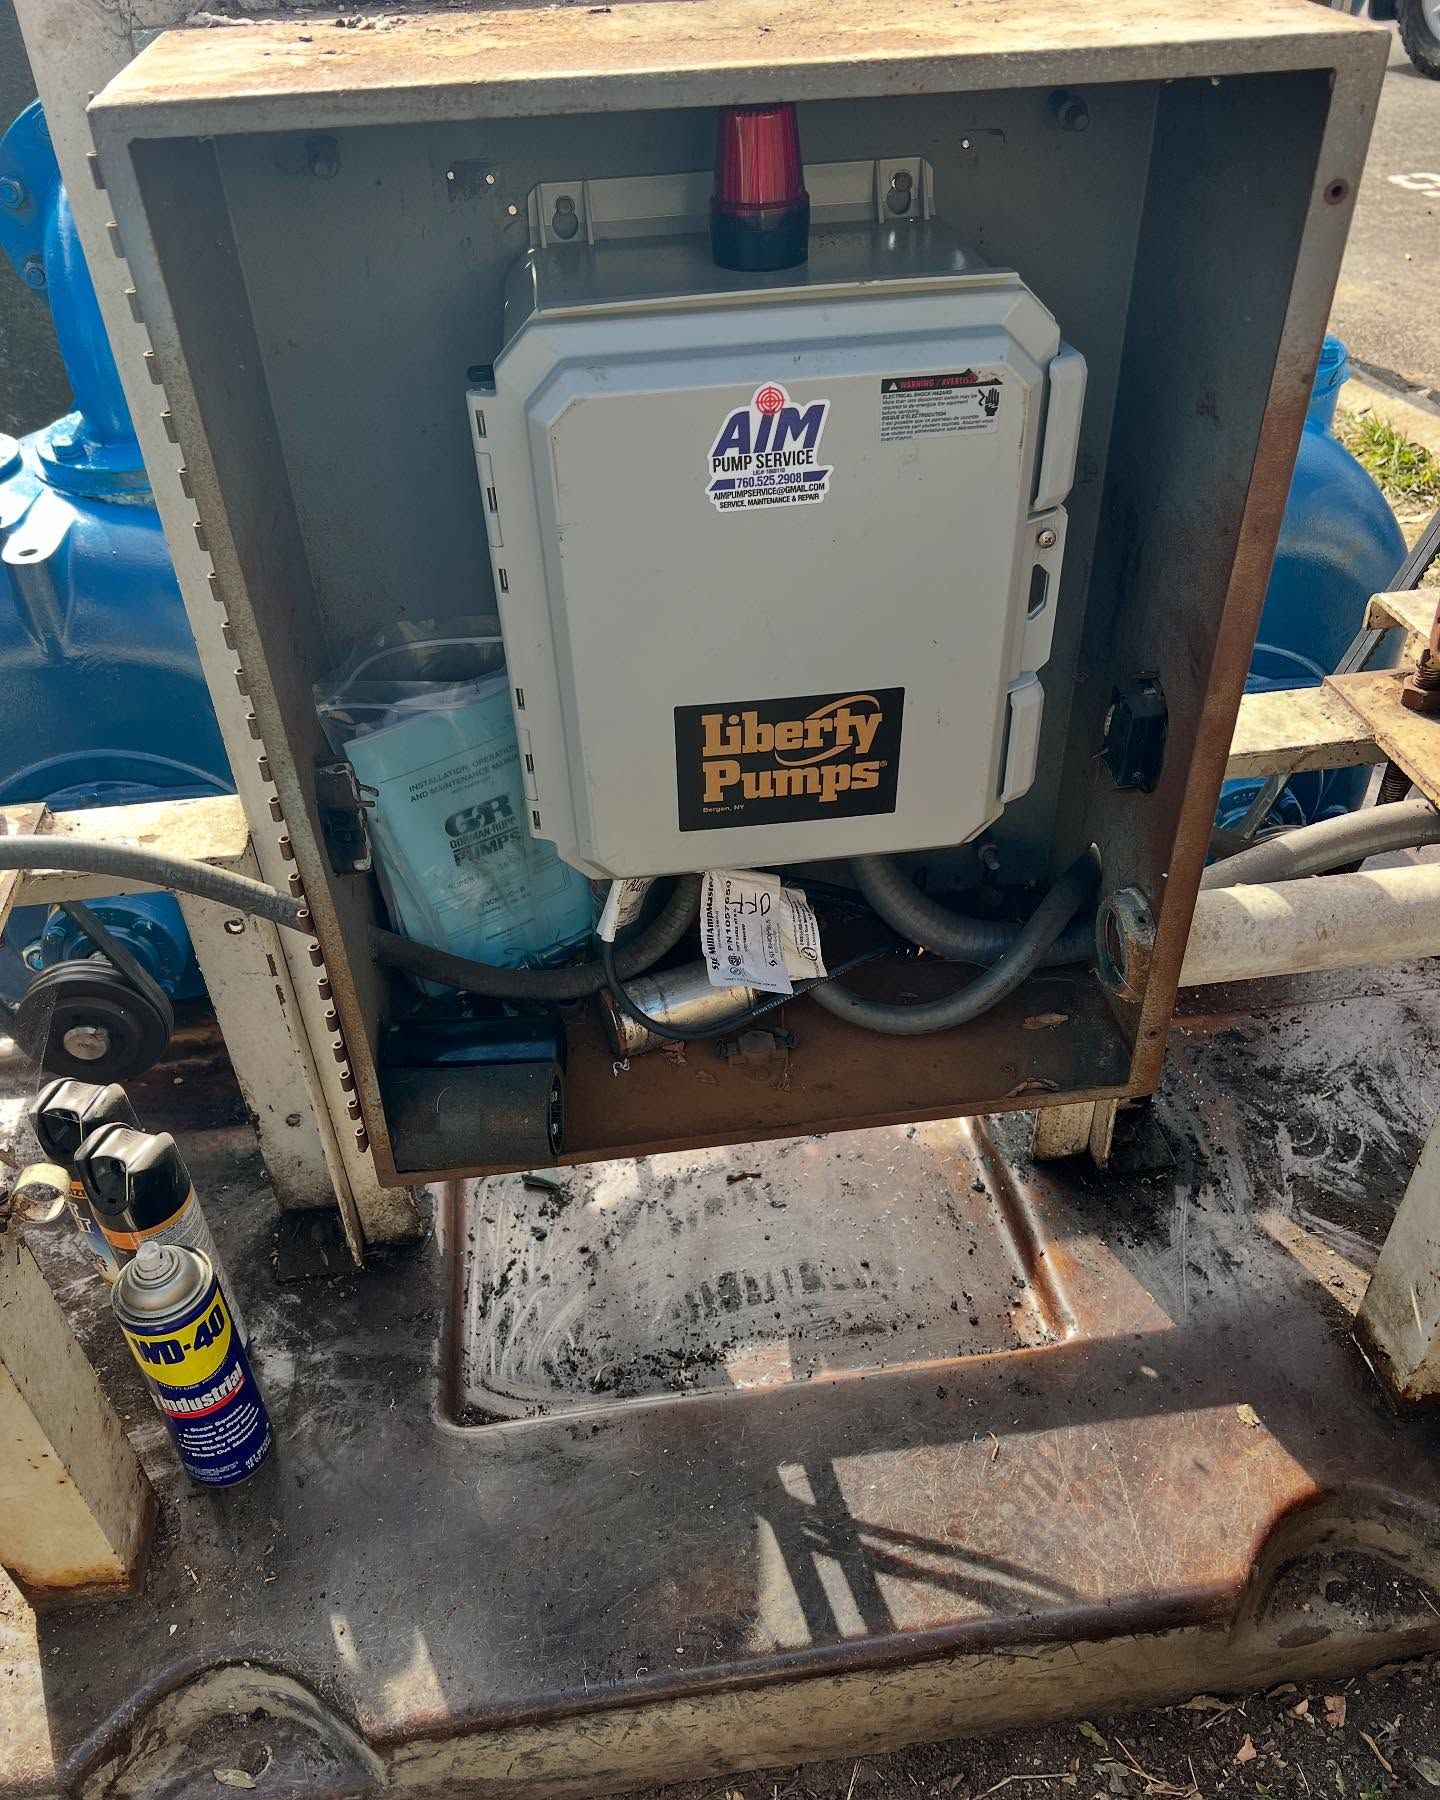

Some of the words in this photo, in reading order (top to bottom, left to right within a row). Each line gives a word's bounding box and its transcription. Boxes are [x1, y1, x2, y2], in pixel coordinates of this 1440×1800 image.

[882, 392, 912, 400] ELECTRICAL
[931, 389, 953, 397] HAZARD
[712, 404, 825, 457] AIM
[712, 455, 752, 473] PUMP
[756, 450, 814, 469] SERVICE
[714, 483, 825, 500] AIMPUMPSERVICE@GMAIL.COM
[736, 472, 802, 489] 760.525.2908
[720, 500, 746, 509] SERVICE,
[748, 496, 790, 506] MAINTENANCE
[798, 492, 820, 502] REPAIR
[701, 707, 883, 757] Liberty
[410, 790, 428, 802] AND
[430, 766, 490, 794] MAINTENANCE
[702, 760, 881, 803] Pumps
[703, 804, 732, 814] Bergen,
[734, 804, 745, 812] NY
[454, 830, 521, 867] PUMPS
[712, 958, 720, 971] SJE
[130, 1304, 224, 1365] WD-40
[158, 1360, 243, 1412] Industrial
[190, 1424, 213, 1432] Stops
[214, 1404, 242, 1426] Squeaks
[214, 1424, 240, 1442] Rusted
[241, 1406, 255, 1426] Parts
[183, 1431, 216, 1439] Removes
[202, 1442, 226, 1451] Sticky
[217, 1446, 232, 1454] Out
[232, 1422, 258, 1448] Moisture
